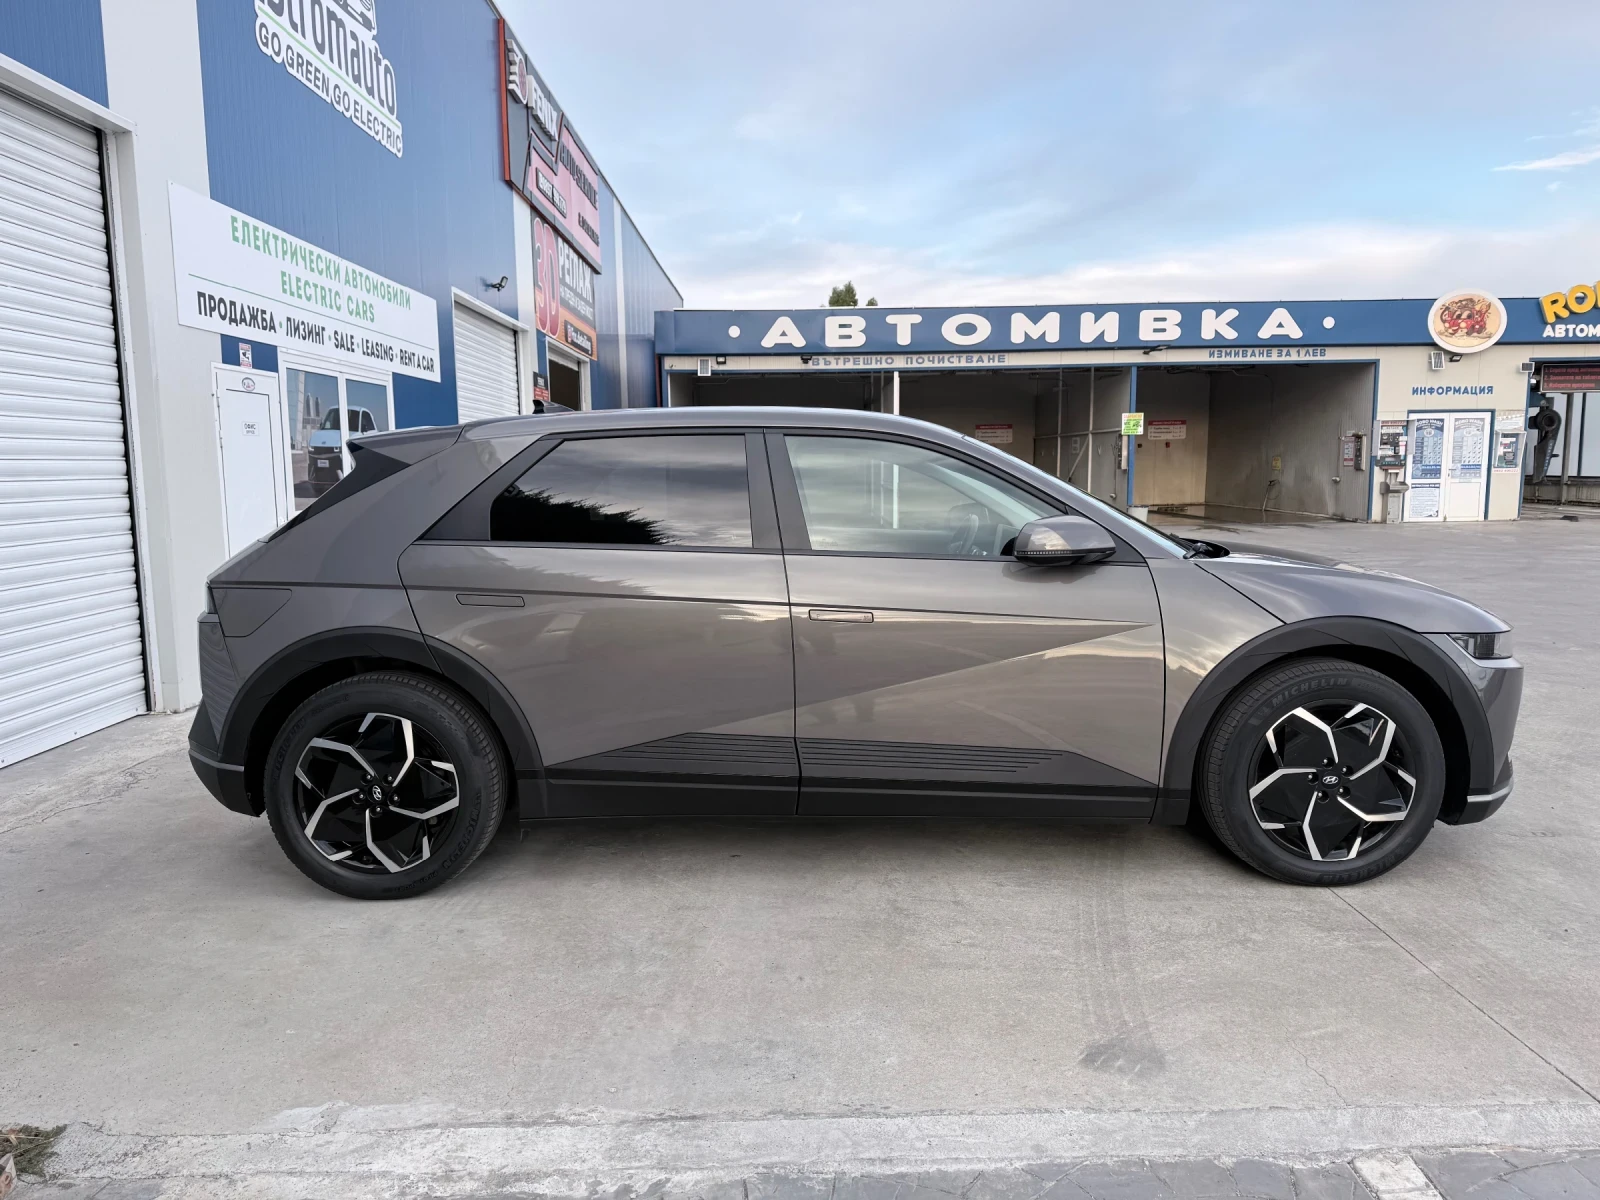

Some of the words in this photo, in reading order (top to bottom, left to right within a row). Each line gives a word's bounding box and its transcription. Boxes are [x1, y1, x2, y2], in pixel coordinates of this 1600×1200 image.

[259, 22, 281, 57] GO
[285, 44, 330, 97] GREEN
[333, 83, 351, 113] GO
[353, 99, 401, 153] ELECTRIC
[527, 74, 558, 141] FENIX
[230, 214, 341, 283] ЕЛЕКТРИЧЕСКИ
[344, 265, 411, 310] АВТОМОБИЛИ
[533, 217, 561, 338] 3D
[558, 236, 592, 302] РЕГЛАЖ
[280, 270, 341, 312] ELECTRIC
[347, 295, 375, 323] CARS
[1540, 280, 1600, 324] RO
[197, 291, 277, 334] ПРОДАЖБА
[286, 316, 325, 346] ЛИЗИНГ
[333, 329, 355, 353] SALE
[361, 338, 394, 362] LEASING
[400, 348, 416, 368] RENT
[416, 353, 422, 369] A
[422, 355, 435, 373] CAR
[760, 307, 1303, 348] АВТОМИВКА
[1208, 348, 1273, 358] ИЗМИВАНЕ
[1276, 348, 1292, 358] ЗА
[1296, 348, 1301, 358] 1
[1304, 348, 1327, 358] ЛЕВ
[811, 355, 895, 367] ВЪТРЕШНО
[905, 354, 1006, 366] ПОЧИСТВАНЕ
[1411, 385, 1494, 396] ИНФОРМАЦИЯ
[1271, 678, 1348, 707] MICHELIN
